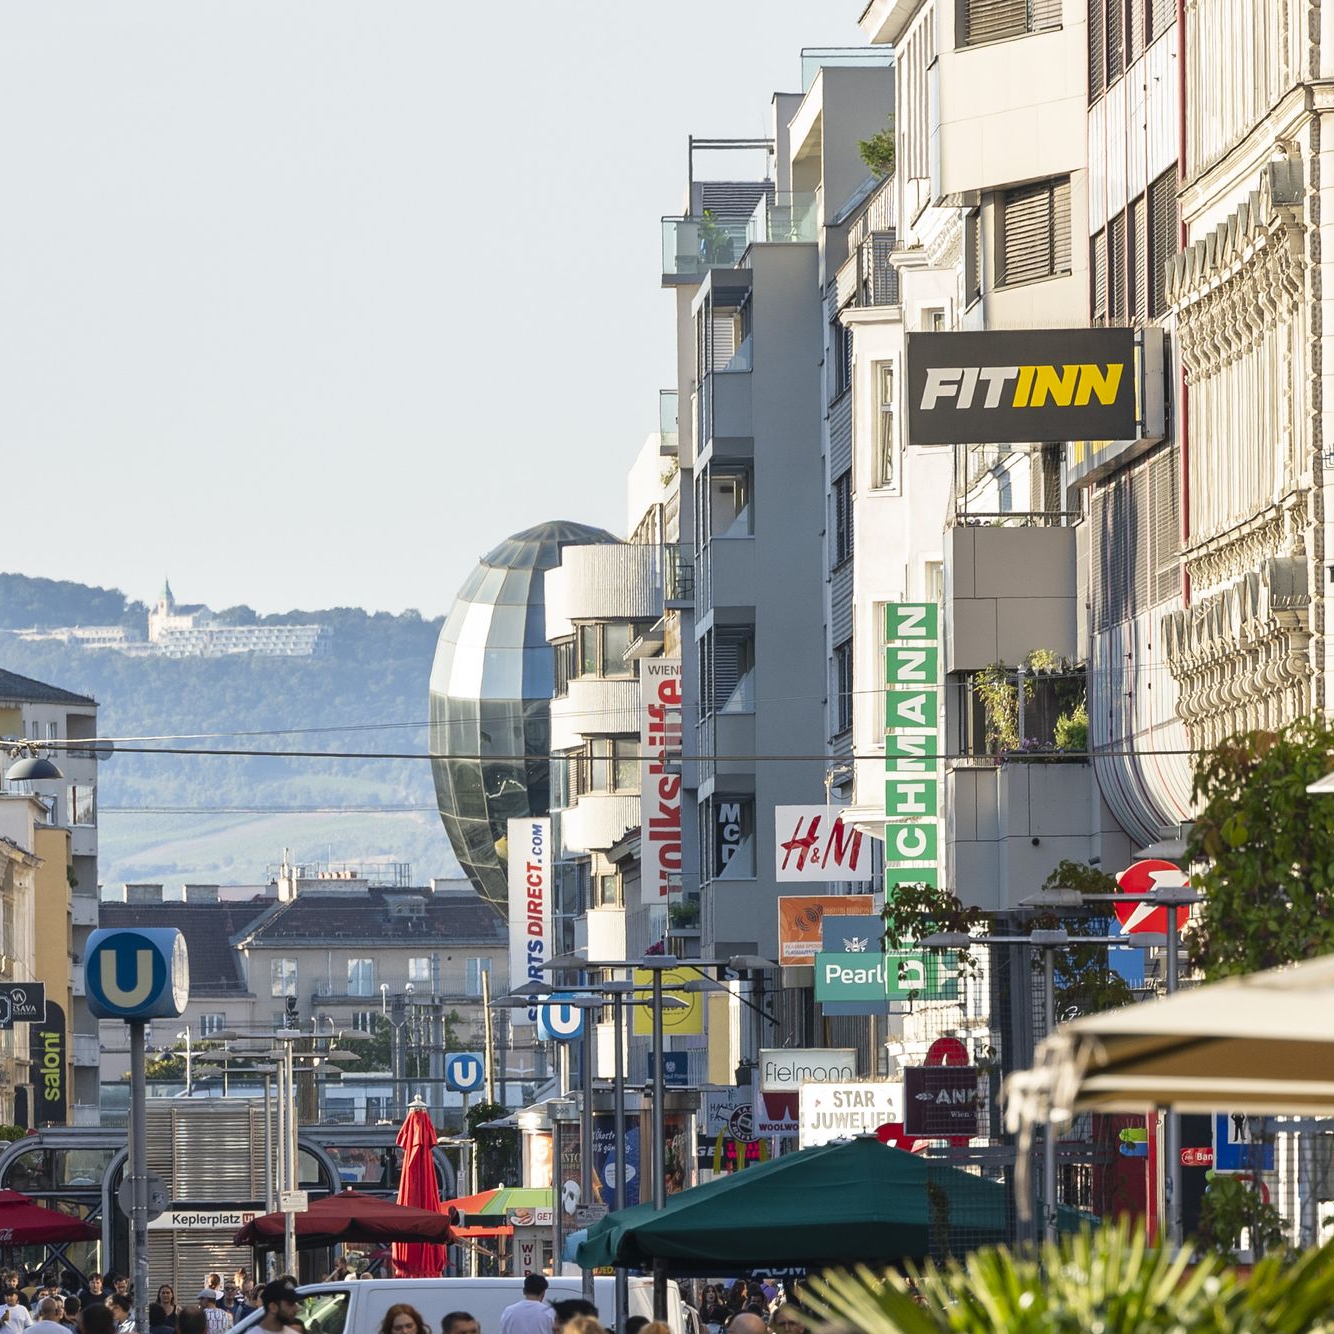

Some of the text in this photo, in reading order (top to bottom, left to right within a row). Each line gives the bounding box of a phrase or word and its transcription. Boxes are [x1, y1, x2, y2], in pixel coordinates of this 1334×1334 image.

[919, 363, 1124, 410] FITINN
[895, 604, 929, 989] DICHMANN
[780, 815, 863, 872] H&M
[100, 950, 153, 1008] U
[825, 964, 887, 985] Pearl
[548, 1004, 583, 1035] U
[40, 1031, 60, 1102] saloni
[453, 1060, 478, 1088] U
[765, 1061, 853, 1082] fielmann
[833, 1090, 875, 1108] STAR
[935, 1088, 978, 1104] ANK
[758, 1123, 799, 1132] WOOLWO
[811, 1111, 897, 1130] JUWELIER
[1196, 1152, 1214, 1161] Ban
[172, 1213, 241, 1228] Keplerplatz
[536, 1212, 553, 1221] GET
